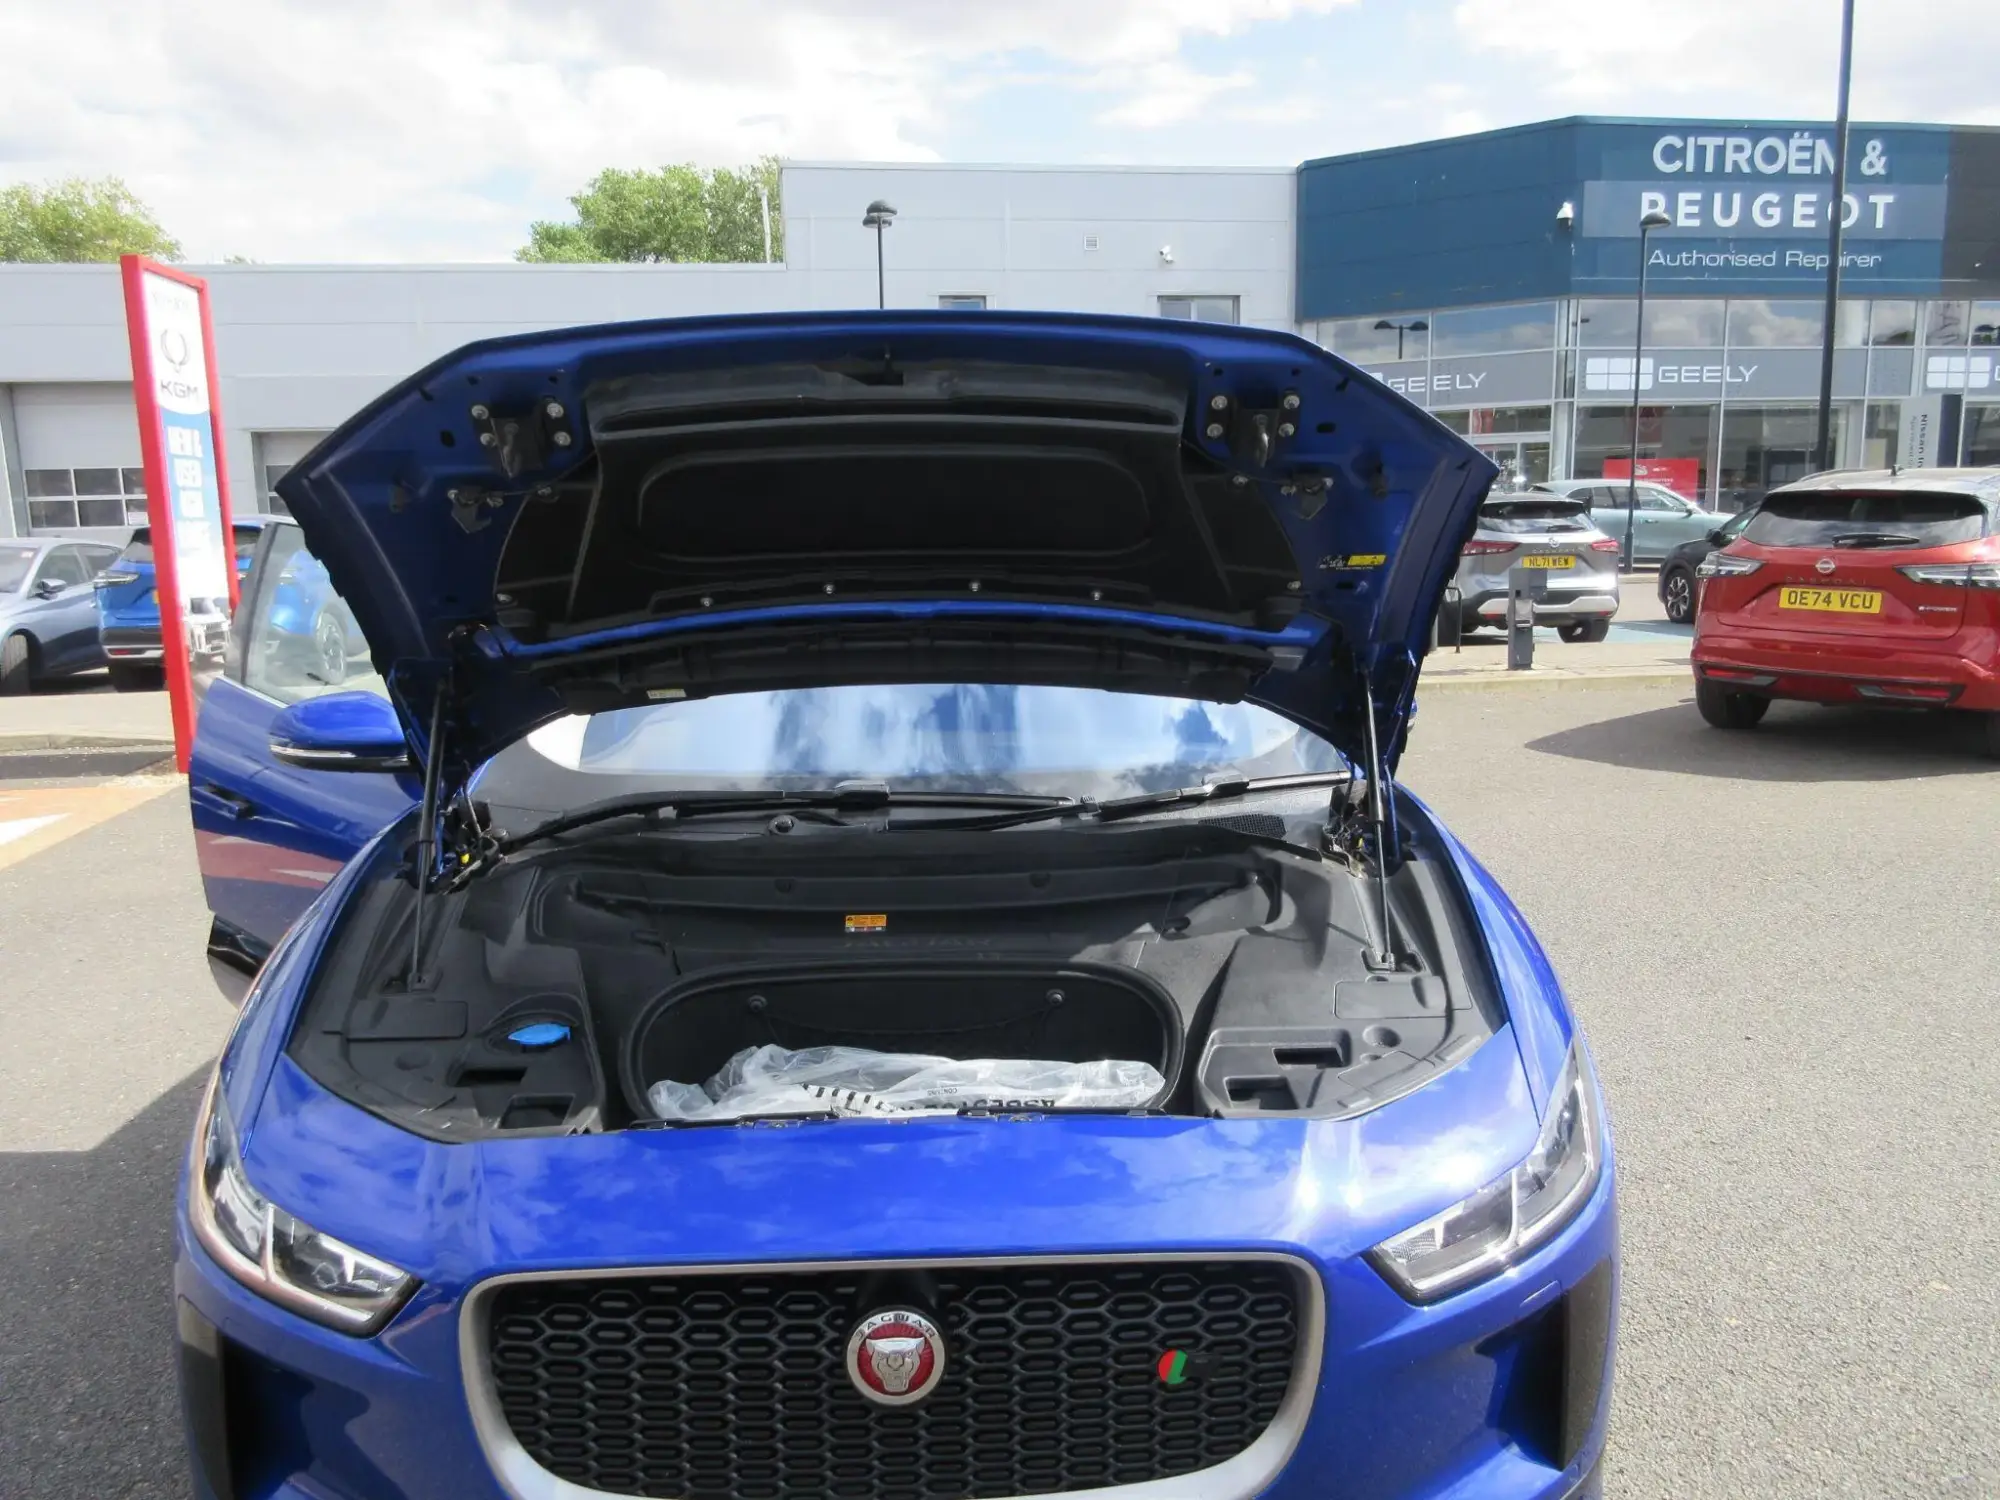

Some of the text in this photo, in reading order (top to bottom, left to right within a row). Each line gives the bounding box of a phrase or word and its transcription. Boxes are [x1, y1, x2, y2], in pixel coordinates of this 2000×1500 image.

[1652, 131, 1888, 175] CITROËN &
[1640, 191, 1895, 229] PEUGEOT
[1648, 249, 1882, 271] Authorised Repirer
[1387, 371, 1487, 393] GEELY
[1657, 365, 1758, 384] GEELY
[160, 380, 199, 402] KGM
[1787, 589, 1874, 610] OE74 VCU
[857, 1312, 936, 1341] JAGUAR
